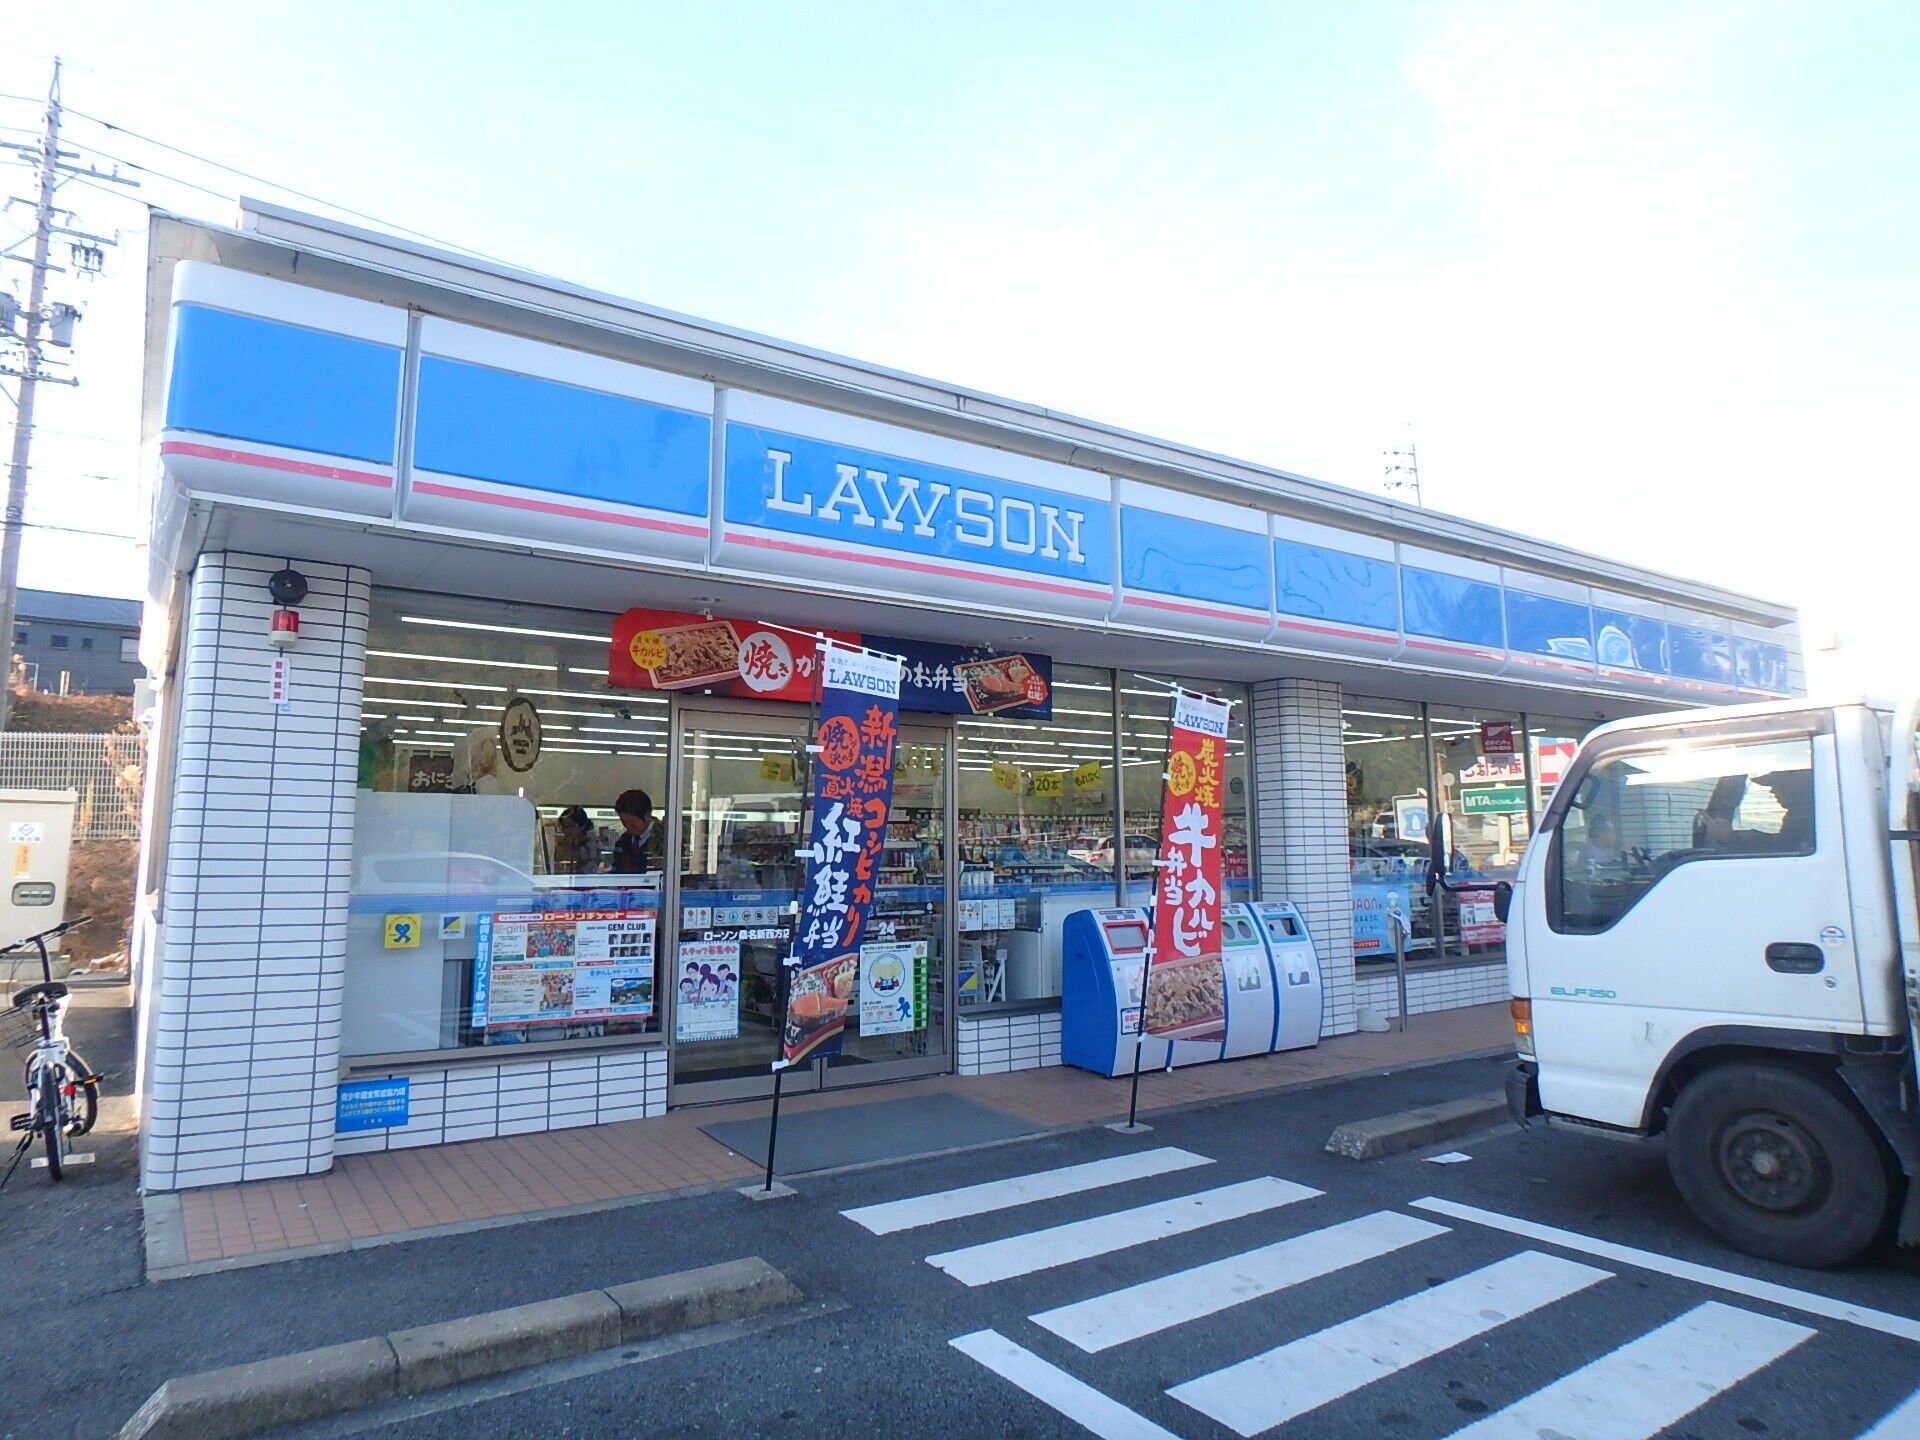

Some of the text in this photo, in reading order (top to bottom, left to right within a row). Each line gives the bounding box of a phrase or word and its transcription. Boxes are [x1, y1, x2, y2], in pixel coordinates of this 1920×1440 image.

[766, 448, 1087, 565] LAWSON
[632, 645, 664, 658] 牛カルビ
[829, 668, 897, 694] LAWSON
[1177, 711, 1225, 734] LAWSON
[1036, 778, 1061, 792] 20本
[803, 802, 862, 949] 紅鮭弁当
[1164, 847, 1187, 906] 弁当
[1168, 802, 1217, 957] 牛カルビ
[543, 912, 625, 921] ローソンチケット
[607, 923, 625, 932] GEM
[627, 922, 647, 931] CLUB
[878, 921, 896, 935] 24
[1550, 986, 1617, 999] ELF 250
